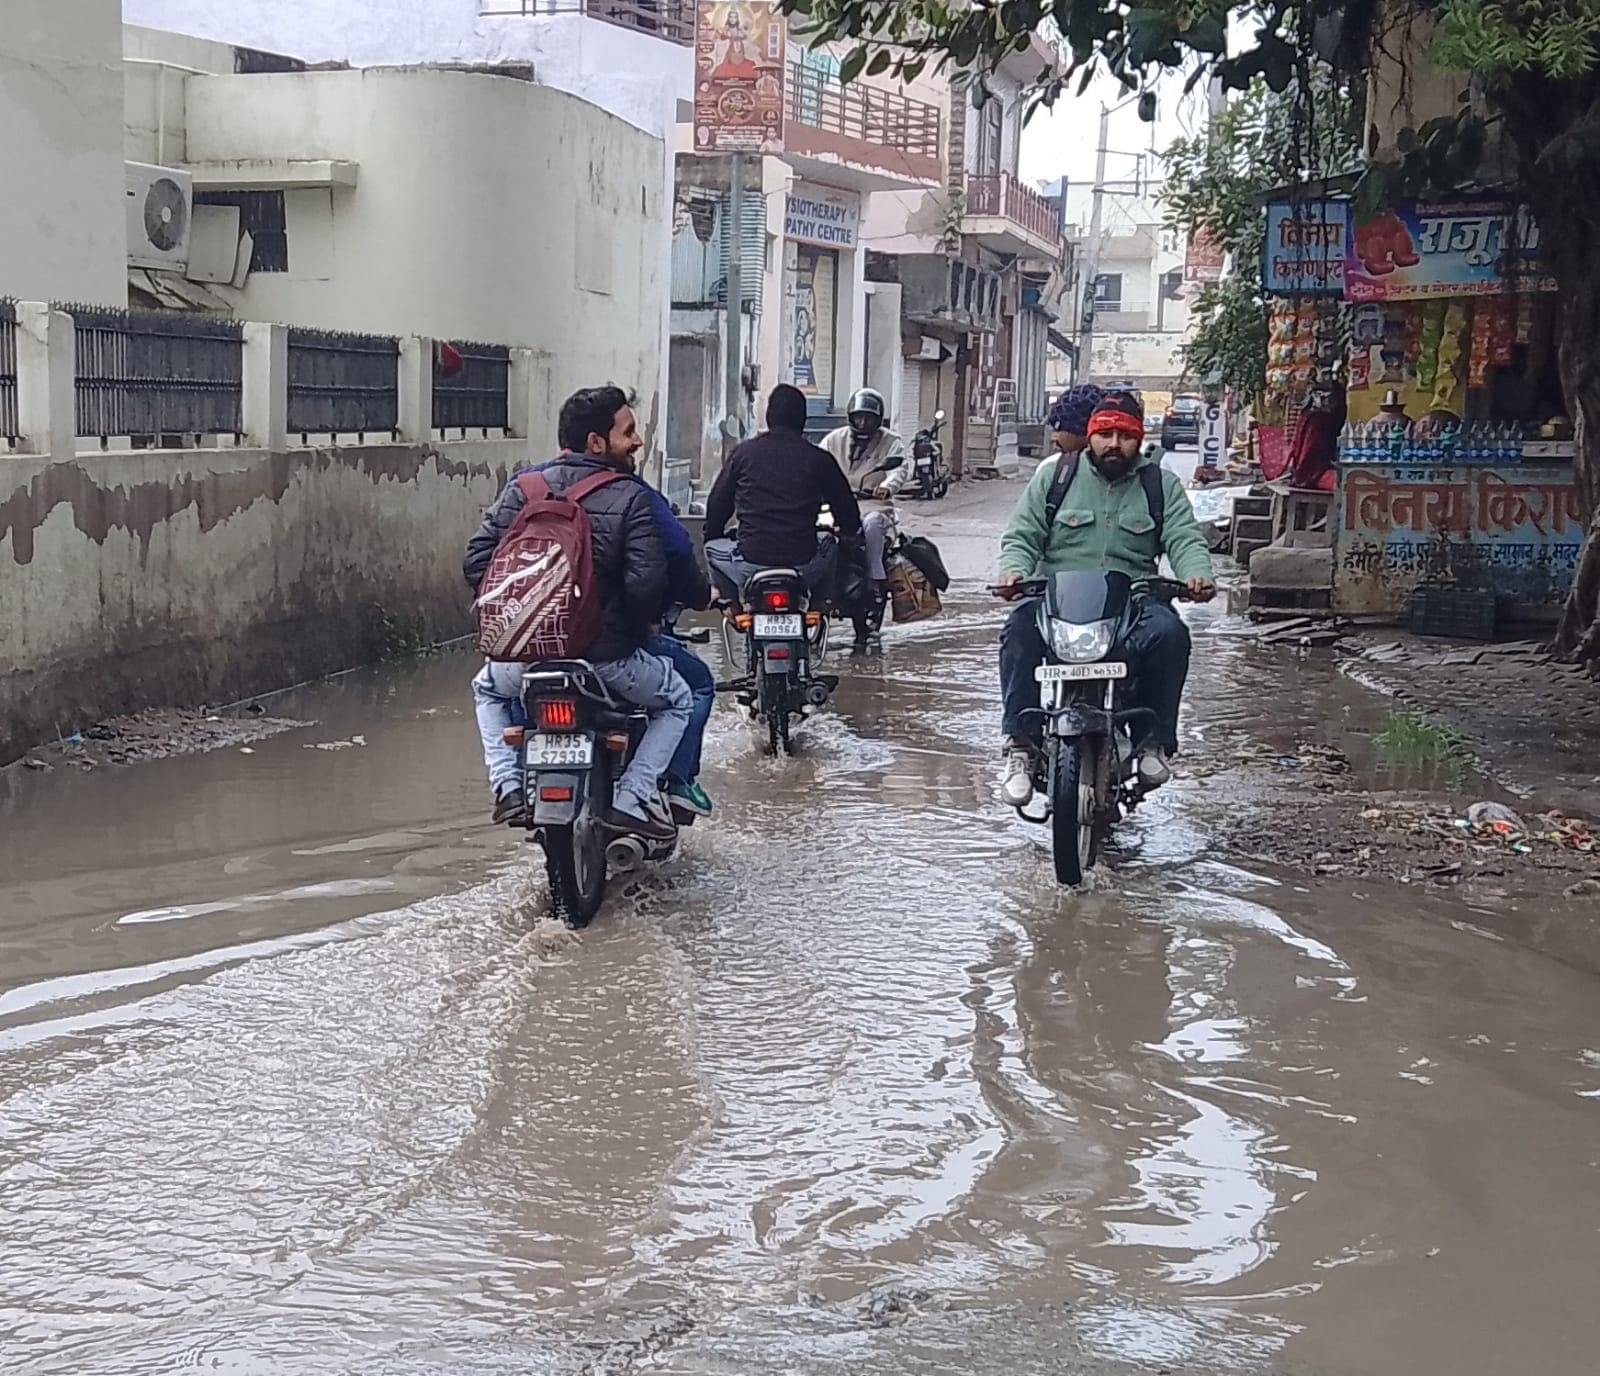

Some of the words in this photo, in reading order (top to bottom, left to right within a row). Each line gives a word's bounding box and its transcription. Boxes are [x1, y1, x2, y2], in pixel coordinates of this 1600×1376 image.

[786, 218, 816, 238] PATHY
[817, 223, 852, 244] CENTRE
[1344, 470, 1472, 533] विनय
[545, 735, 582, 749] HR35
[540, 749, 587, 764] S7939
